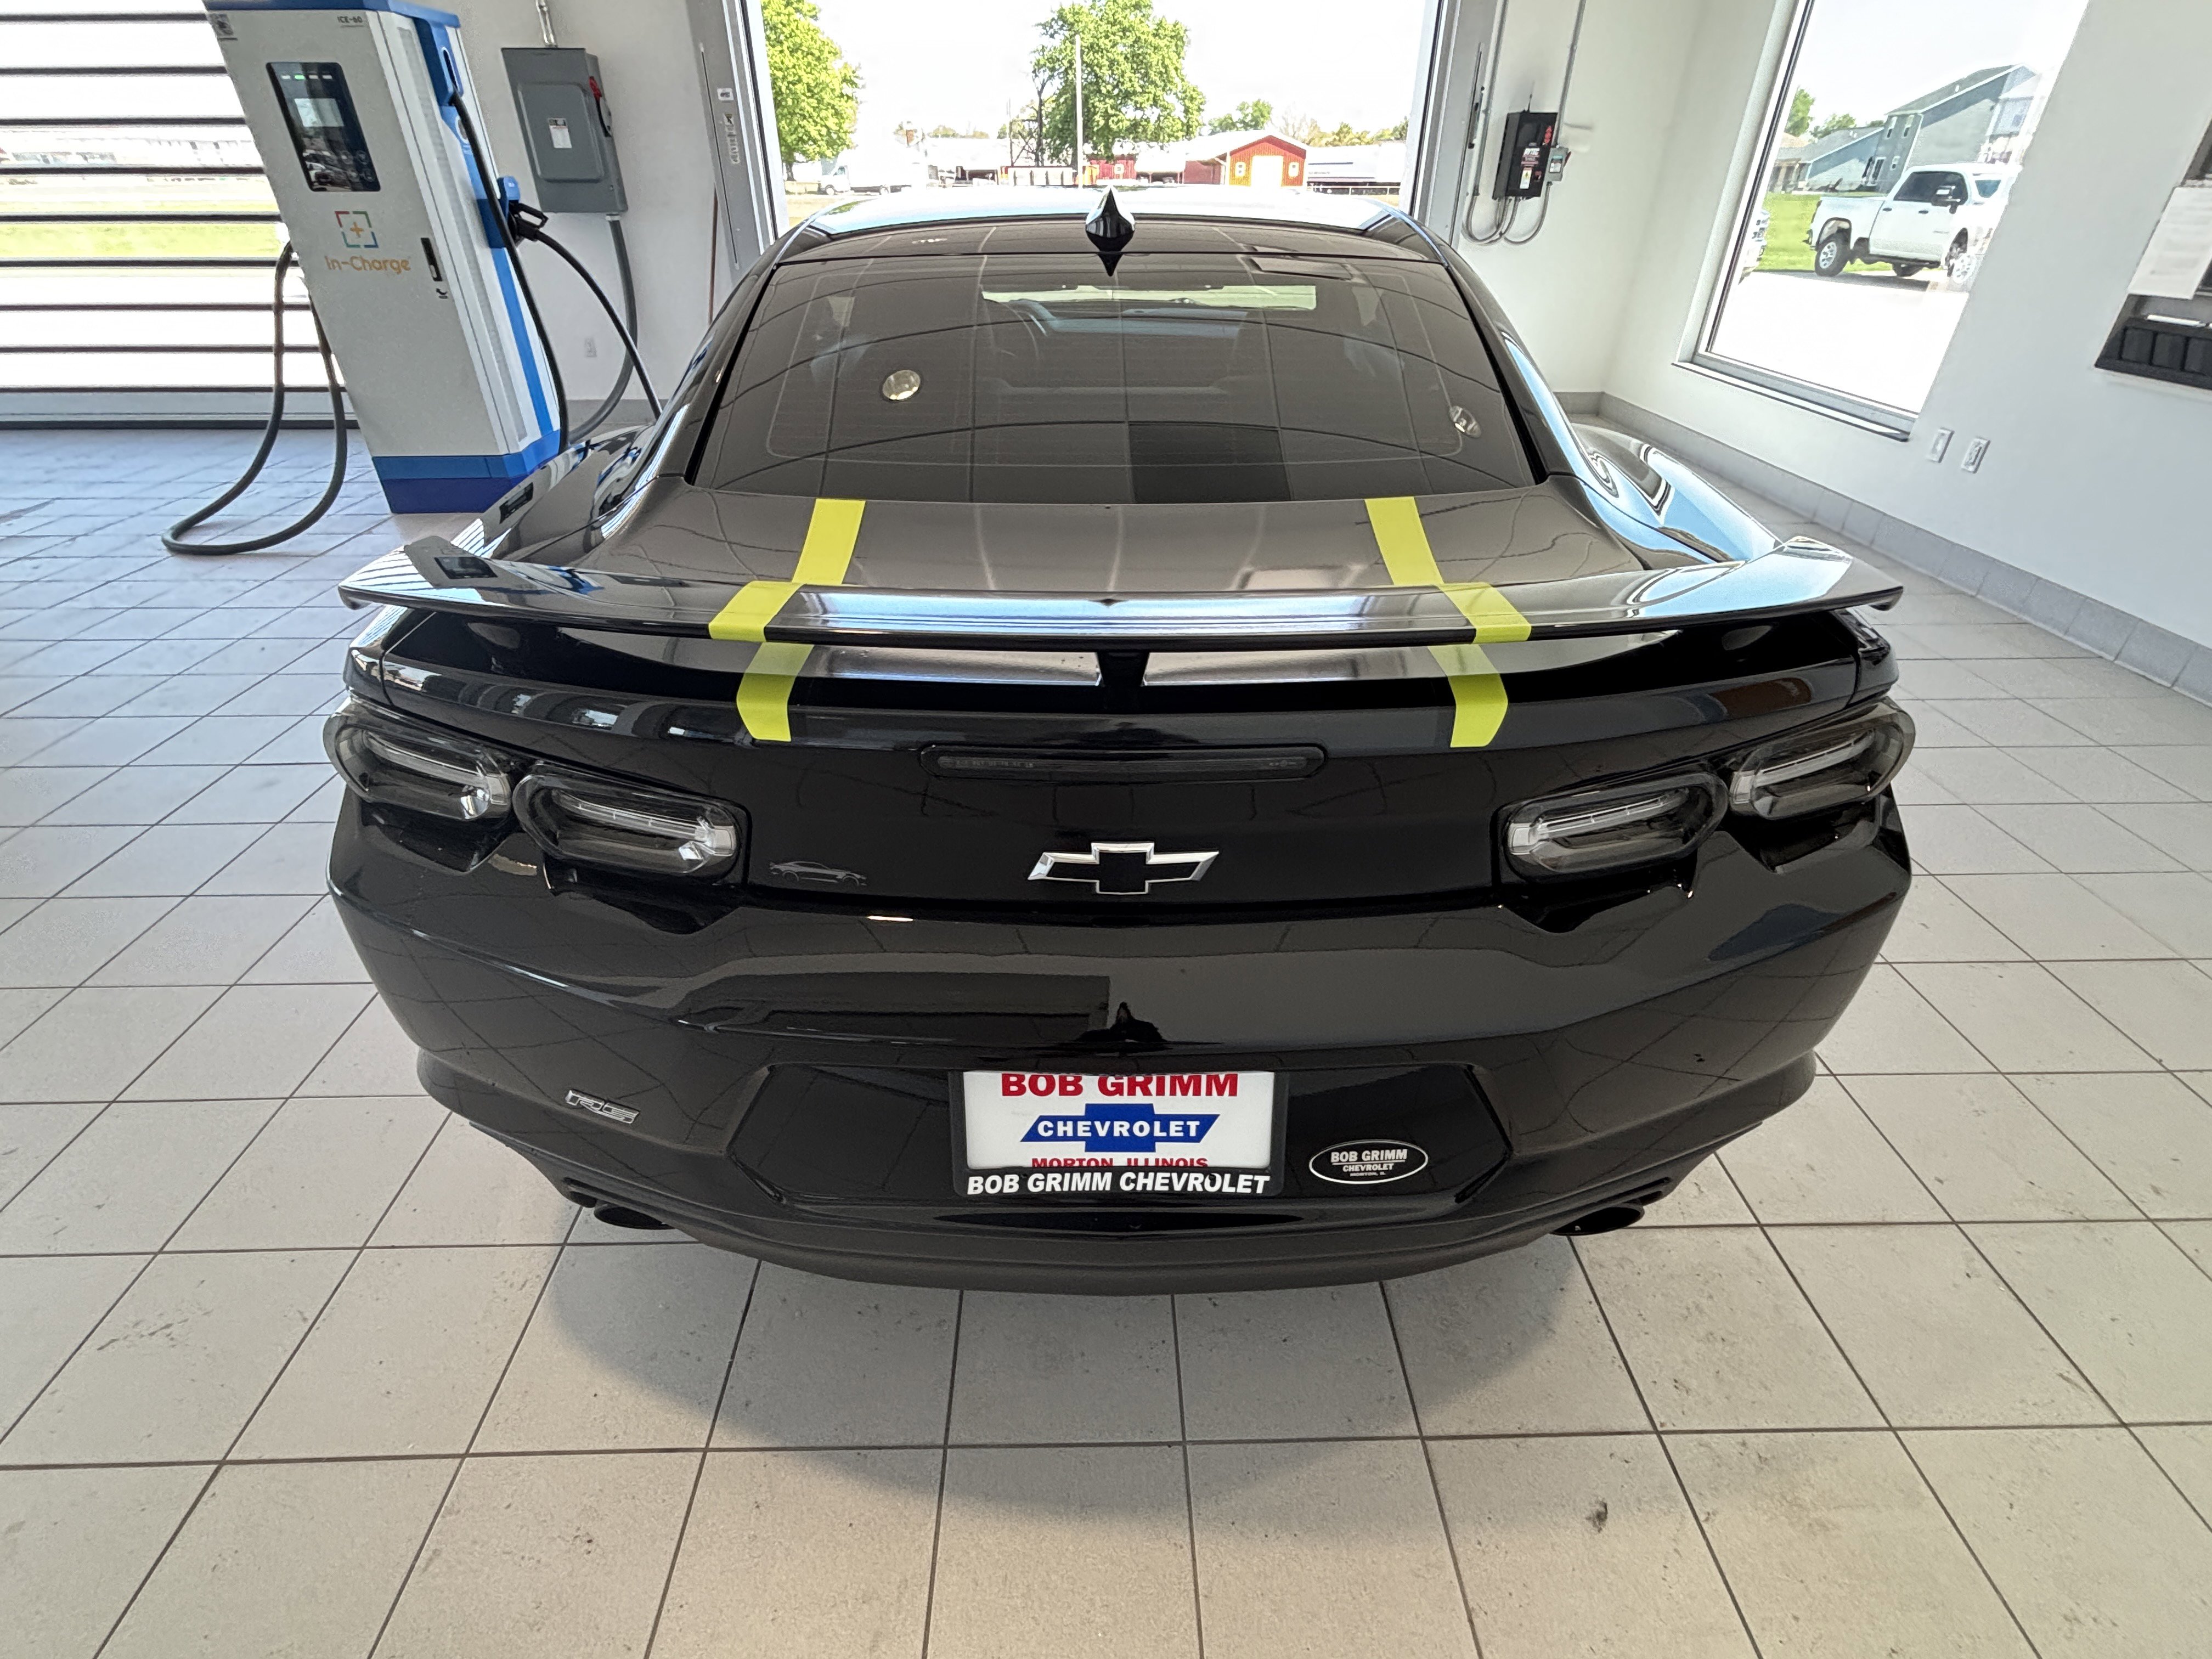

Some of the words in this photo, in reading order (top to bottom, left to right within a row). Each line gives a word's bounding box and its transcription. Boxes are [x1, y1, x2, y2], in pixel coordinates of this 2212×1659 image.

[324, 255, 411, 274] In-Charge
[1001, 1073, 1084, 1097] BOB
[1098, 1073, 1238, 1097] GRIMM
[565, 1090, 640, 1124] RS
[1037, 1120, 1200, 1137] CHEVROLET
[1331, 1151, 1358, 1163] BOB
[1362, 1149, 1407, 1161] GRIMM
[1342, 1163, 1394, 1172] CHEVROLET
[967, 1174, 1019, 1195] BOB
[1027, 1172, 1113, 1193] GRIMM
[1119, 1172, 1271, 1194] CHEVROLET
